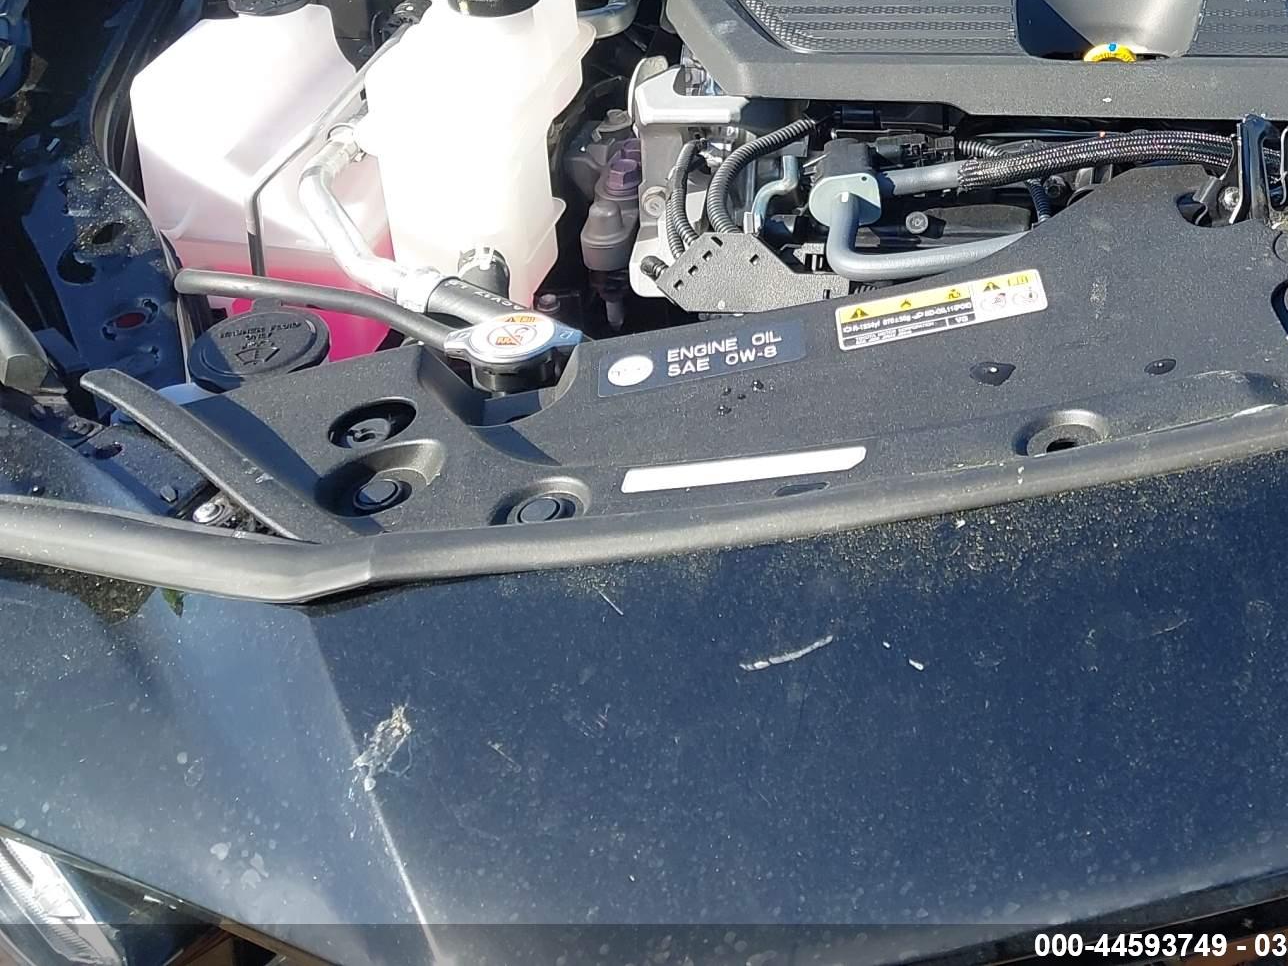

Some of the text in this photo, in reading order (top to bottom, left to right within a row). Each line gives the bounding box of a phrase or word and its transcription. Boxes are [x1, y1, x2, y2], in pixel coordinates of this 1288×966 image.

[667, 329, 783, 362] ENGINE OIL
[667, 358, 711, 377] SAE
